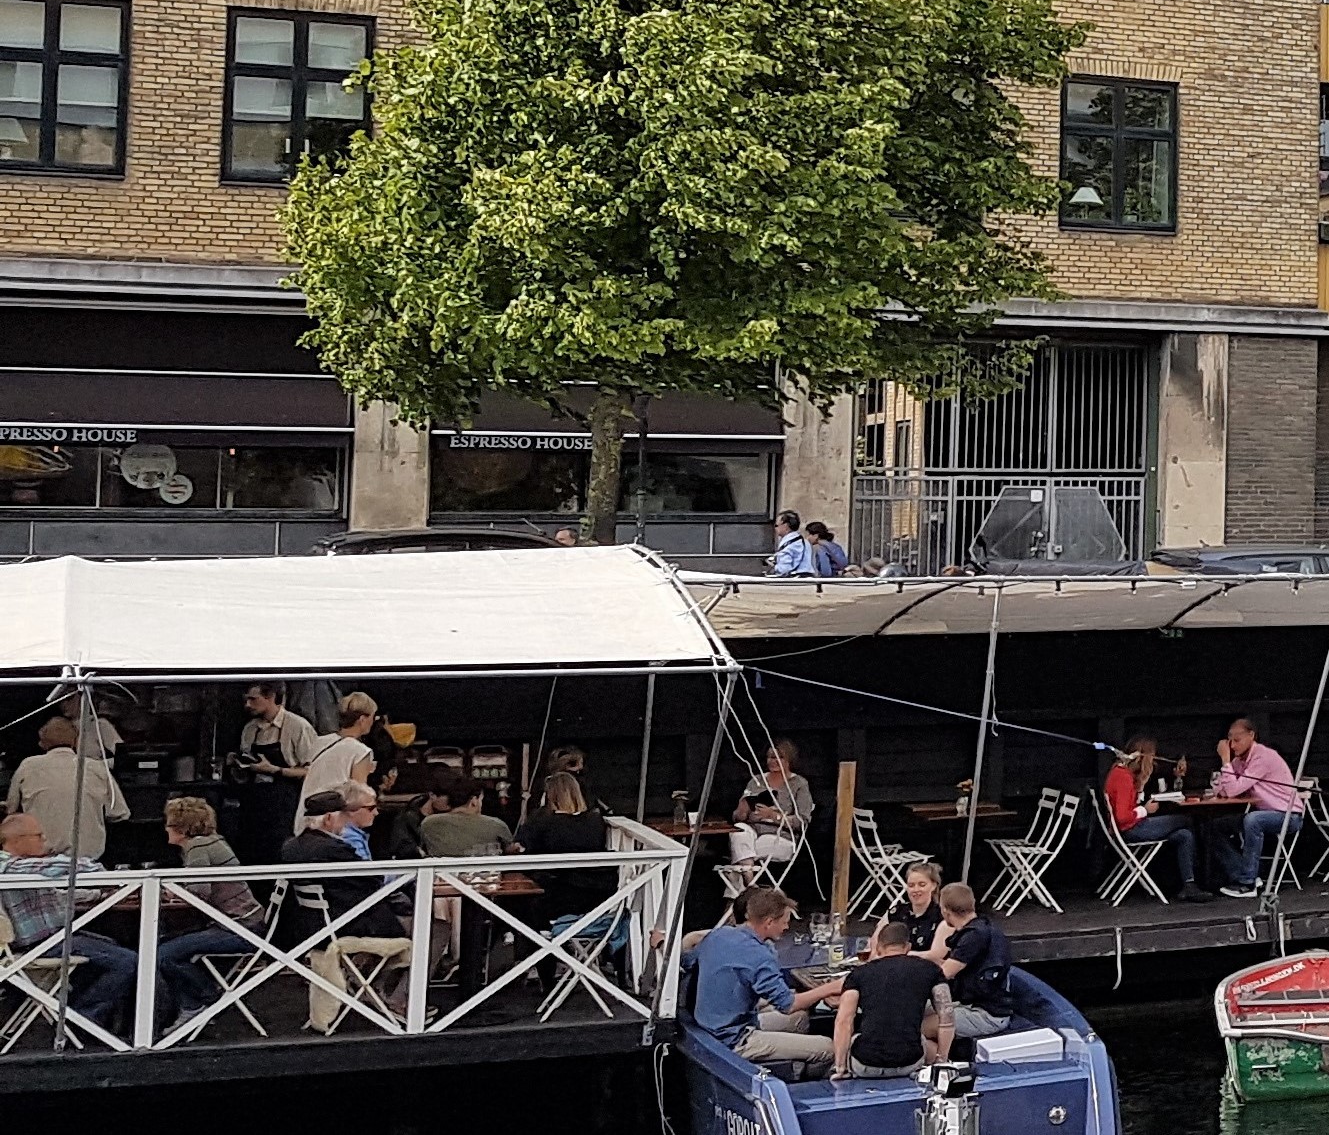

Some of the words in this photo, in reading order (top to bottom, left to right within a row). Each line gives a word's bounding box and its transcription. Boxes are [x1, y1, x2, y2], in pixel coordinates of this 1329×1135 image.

[72, 429, 137, 443] HOUSE
[450, 435, 531, 449] ESPRESSO
[536, 437, 593, 450] HOUSE
